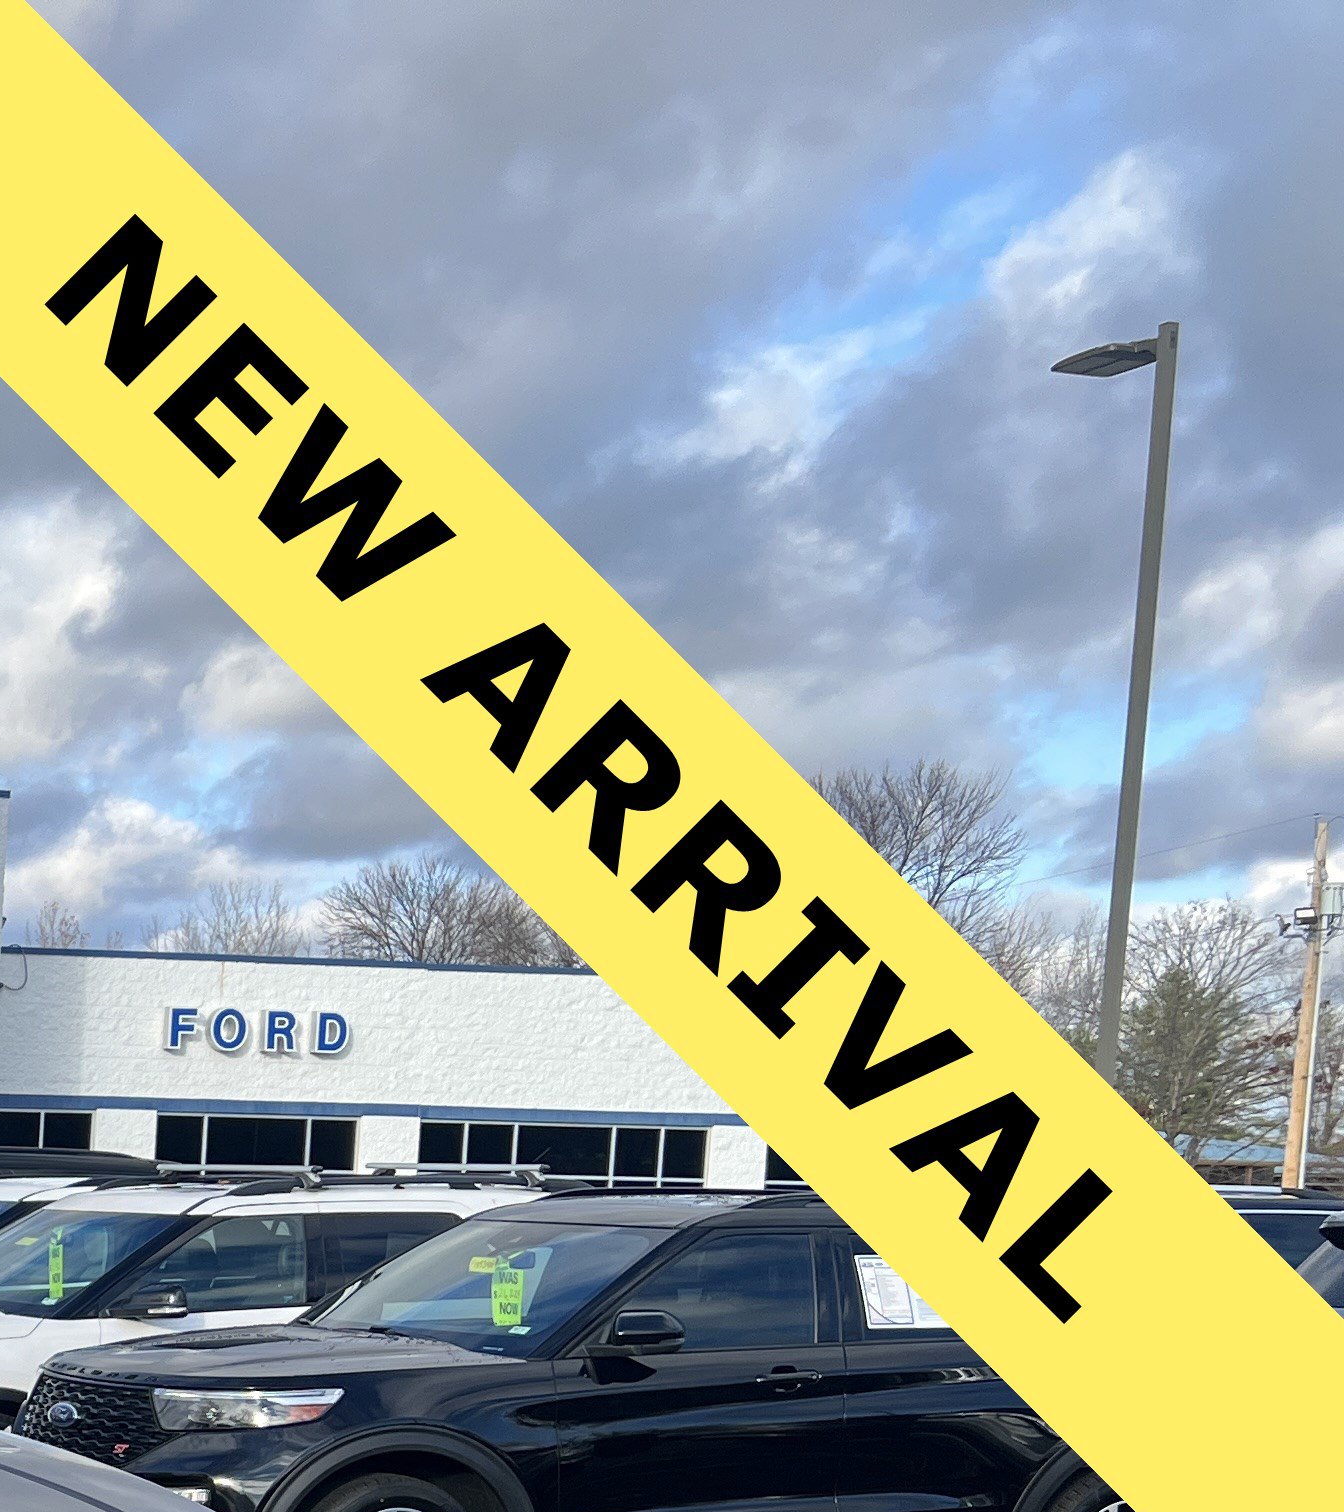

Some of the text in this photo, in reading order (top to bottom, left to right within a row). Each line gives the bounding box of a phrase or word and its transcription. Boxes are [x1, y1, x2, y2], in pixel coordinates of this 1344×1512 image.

[167, 1007, 350, 1052] FORD
[498, 1271, 519, 1285] WAS
[499, 1302, 519, 1315] NOW
